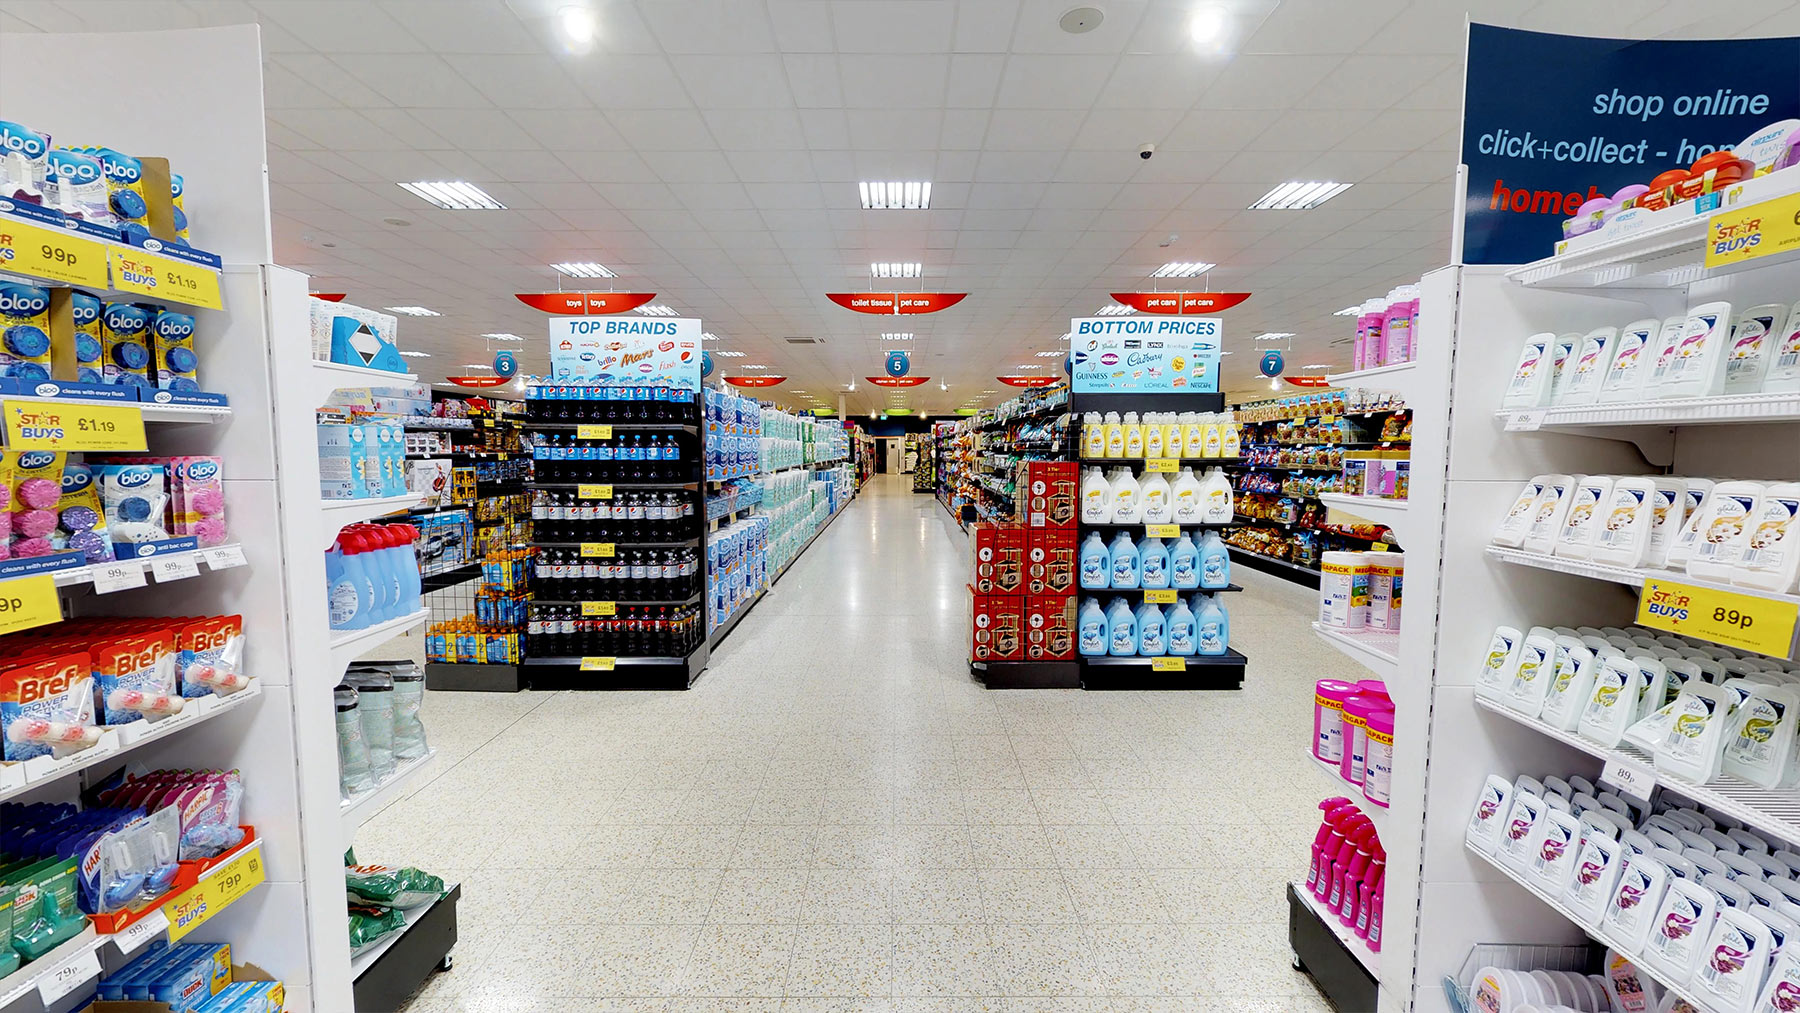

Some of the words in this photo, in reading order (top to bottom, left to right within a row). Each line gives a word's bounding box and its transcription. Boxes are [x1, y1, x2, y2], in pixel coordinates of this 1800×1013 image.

[1593, 88, 1664, 121] shop
[1673, 89, 1769, 116] online
[0, 128, 41, 154] loo
[1478, 129, 1648, 164] click+collect
[103, 159, 137, 179] bloo
[1715, 233, 1761, 254] BUYS
[41, 245, 77, 266] 99p
[123, 271, 157, 287] BUYS
[167, 272, 197, 289] £1.19
[0, 294, 44, 311] bloo
[566, 299, 582, 308] toys
[590, 299, 606, 308] toys
[851, 299, 870, 307] toilet
[870, 299, 893, 307] tissue
[73, 307, 95, 318] oo
[109, 315, 143, 329] bloo
[160, 321, 191, 335] bloo
[569, 321, 600, 334] TOP
[605, 321, 678, 335] BRANDS
[1078, 321, 1154, 335] BOTTOM
[1158, 321, 1216, 335] PRICES
[502, 361, 510, 371] 3
[597, 355, 617, 367] brillo
[620, 350, 654, 368] Mars
[893, 361, 901, 371] 5
[1127, 352, 1163, 367] Cadbury
[1268, 361, 1276, 370] 7
[1076, 372, 1108, 380] GUINNESS
[37, 386, 57, 394] bloo
[21, 427, 64, 438] BUYS
[77, 418, 115, 432] £1.19
[21, 452, 53, 467] bloo
[121, 470, 150, 484] bloo
[189, 463, 216, 476] bloo
[62, 474, 88, 486] oo
[1, 564, 25, 573] cleans
[26, 562, 41, 570] with
[42, 560, 60, 568] every
[61, 557, 77, 565] flush
[164, 562, 182, 571] 99p
[108, 568, 127, 578] 99p
[1649, 603, 1689, 620] BUYS
[1713, 607, 1753, 629] 89p
[193, 626, 234, 653] Bref
[116, 643, 162, 677] Bref
[196, 649, 226, 661] POWE
[19, 666, 78, 705] Bref
[23, 694, 69, 714] POWER
[1617, 767, 1635, 784] 89p
[84, 848, 101, 876] HAR
[217, 873, 242, 893] 79p
[177, 902, 207, 928] BUYS
[128, 922, 149, 937] 99p
[55, 966, 78, 981] 79p
